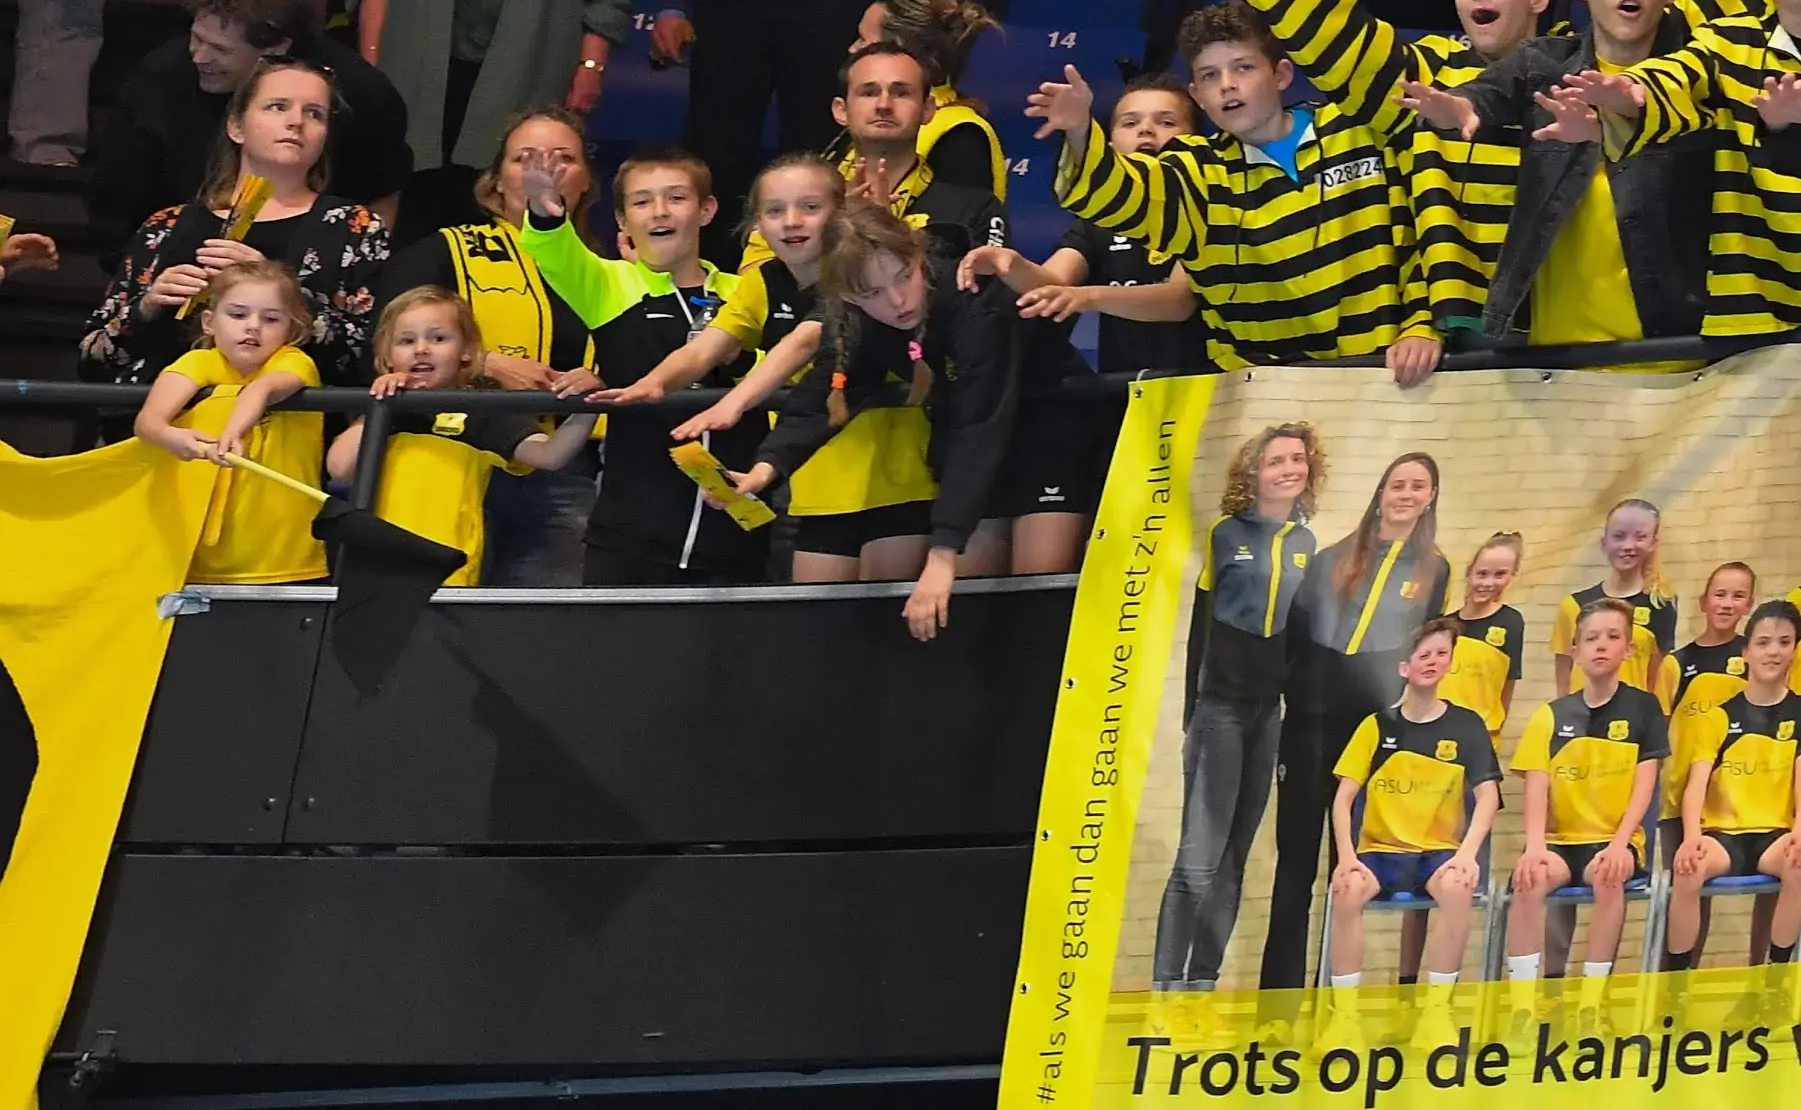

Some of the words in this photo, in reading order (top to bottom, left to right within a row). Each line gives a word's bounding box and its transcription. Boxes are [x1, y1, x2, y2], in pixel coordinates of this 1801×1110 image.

[1046, 31, 1077, 49] 14
[1147, 419, 1177, 504] allen
[1132, 514, 1167, 557] z'n
[1118, 565, 1151, 632] met
[1107, 643, 1133, 694] we
[1092, 703, 1122, 787] gaan
[1070, 798, 1108, 865] dan
[1062, 875, 1095, 959] gaan
[1054, 970, 1076, 1022] we
[1037, 1031, 1067, 1105] #als
[1126, 1034, 1300, 1097] Trots
[1318, 1035, 1404, 1108] op
[1425, 1026, 1511, 1088] de
[1532, 1018, 1769, 1094] kanjers
